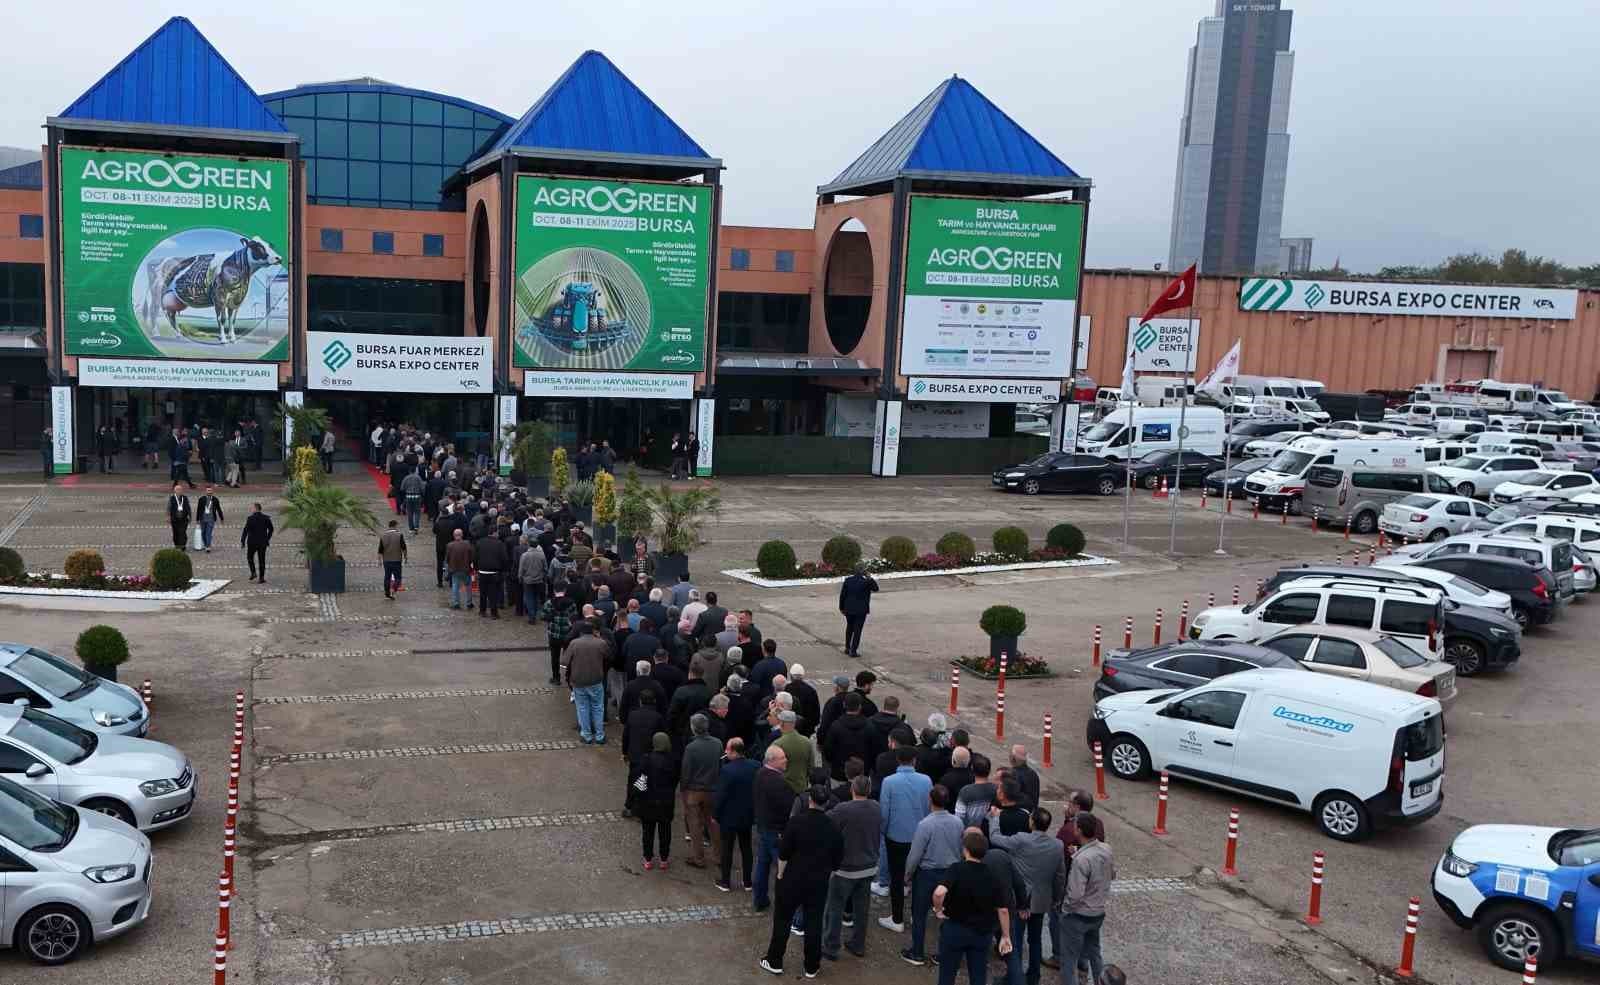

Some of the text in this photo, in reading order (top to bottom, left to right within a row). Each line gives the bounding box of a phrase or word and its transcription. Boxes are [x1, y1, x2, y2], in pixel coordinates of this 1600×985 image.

[81, 159, 272, 190] AGROGREEN
[84, 191, 109, 200] OCT.
[112, 192, 141, 202] 08-11
[174, 195, 201, 206] 2025
[204, 193, 272, 212] BURSA
[534, 185, 697, 214] AGROGREEN
[976, 207, 1019, 220] BURSA
[535, 216, 557, 224] OCT.
[559, 216, 584, 226] 08-11
[611, 219, 635, 229] 2025
[638, 217, 695, 233] BURSA
[937, 218, 964, 228] TARIM
[975, 221, 1031, 231] HAYVANCILIK
[927, 246, 1062, 270] AGROGREEN
[1012, 274, 1060, 288] BURSA
[1329, 289, 1521, 311] BURSA EXPO CENTER
[1159, 326, 1189, 334] BURSA
[1159, 335, 1183, 343] EXPO
[356, 344, 484, 356] BURSA FUAR MERKEZİ
[87, 365, 122, 373] BURSA
[126, 366, 157, 374] TARIM
[171, 367, 239, 376] HAYVANCILIK
[240, 369, 271, 377] FUARI
[356, 359, 480, 371] BURSA EXPO CENTER
[603, 378, 660, 386] HAYVANCILIK
[662, 379, 688, 387] FUARI
[929, 383, 1042, 395] BURSA EXPO CENTER
[1273, 705, 1354, 733] Landini
